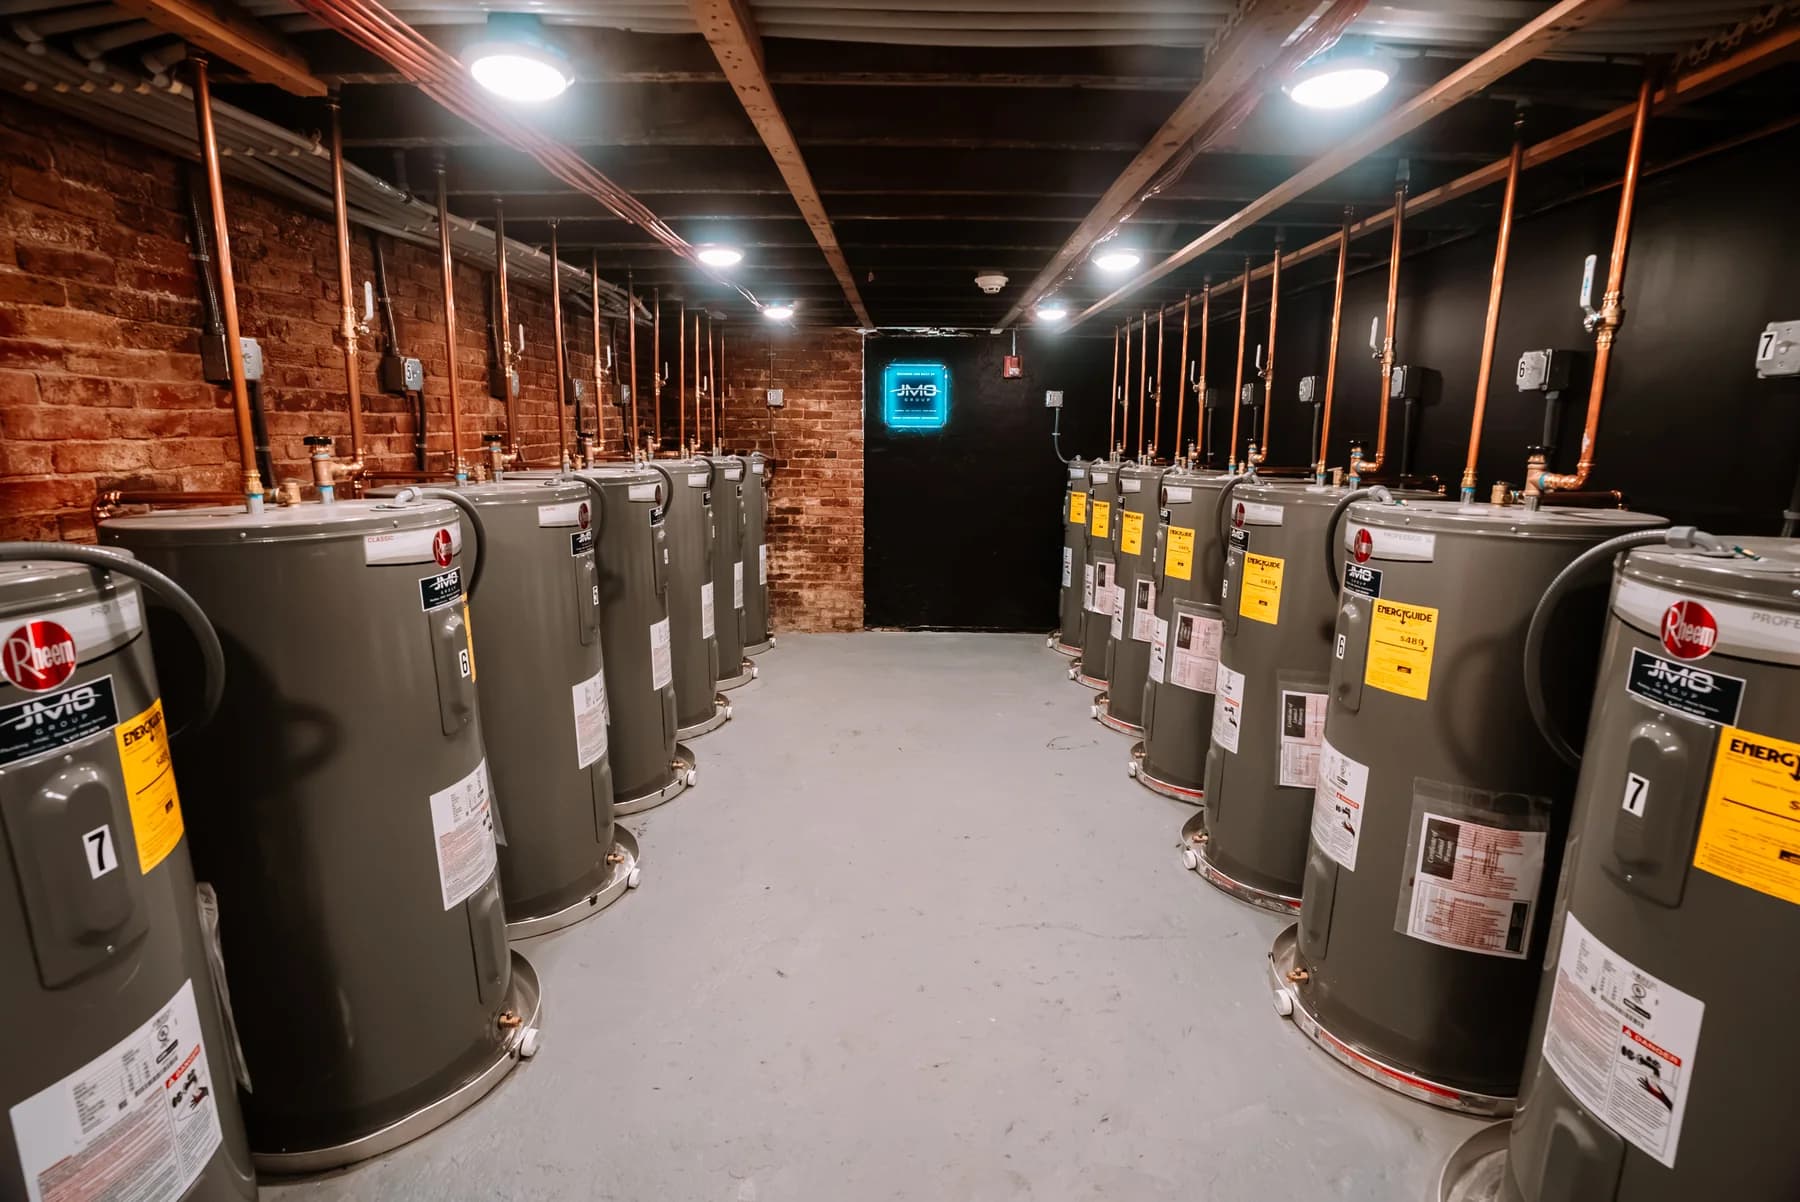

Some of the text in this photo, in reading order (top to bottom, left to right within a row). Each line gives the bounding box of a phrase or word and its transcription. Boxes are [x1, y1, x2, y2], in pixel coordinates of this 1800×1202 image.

[1763, 334, 1774, 358] 7
[1518, 361, 1526, 378] 6
[896, 384, 937, 397] JMO
[434, 571, 458, 590] JMO
[1664, 600, 1715, 648] Rheem
[8, 621, 75, 682] Rheem
[1338, 636, 1344, 656] 6
[461, 652, 468, 674] 6
[1647, 659, 1715, 694] JMO
[13, 686, 97, 731] JMO
[1629, 777, 1645, 810] 7
[88, 830, 106, 871] 7
